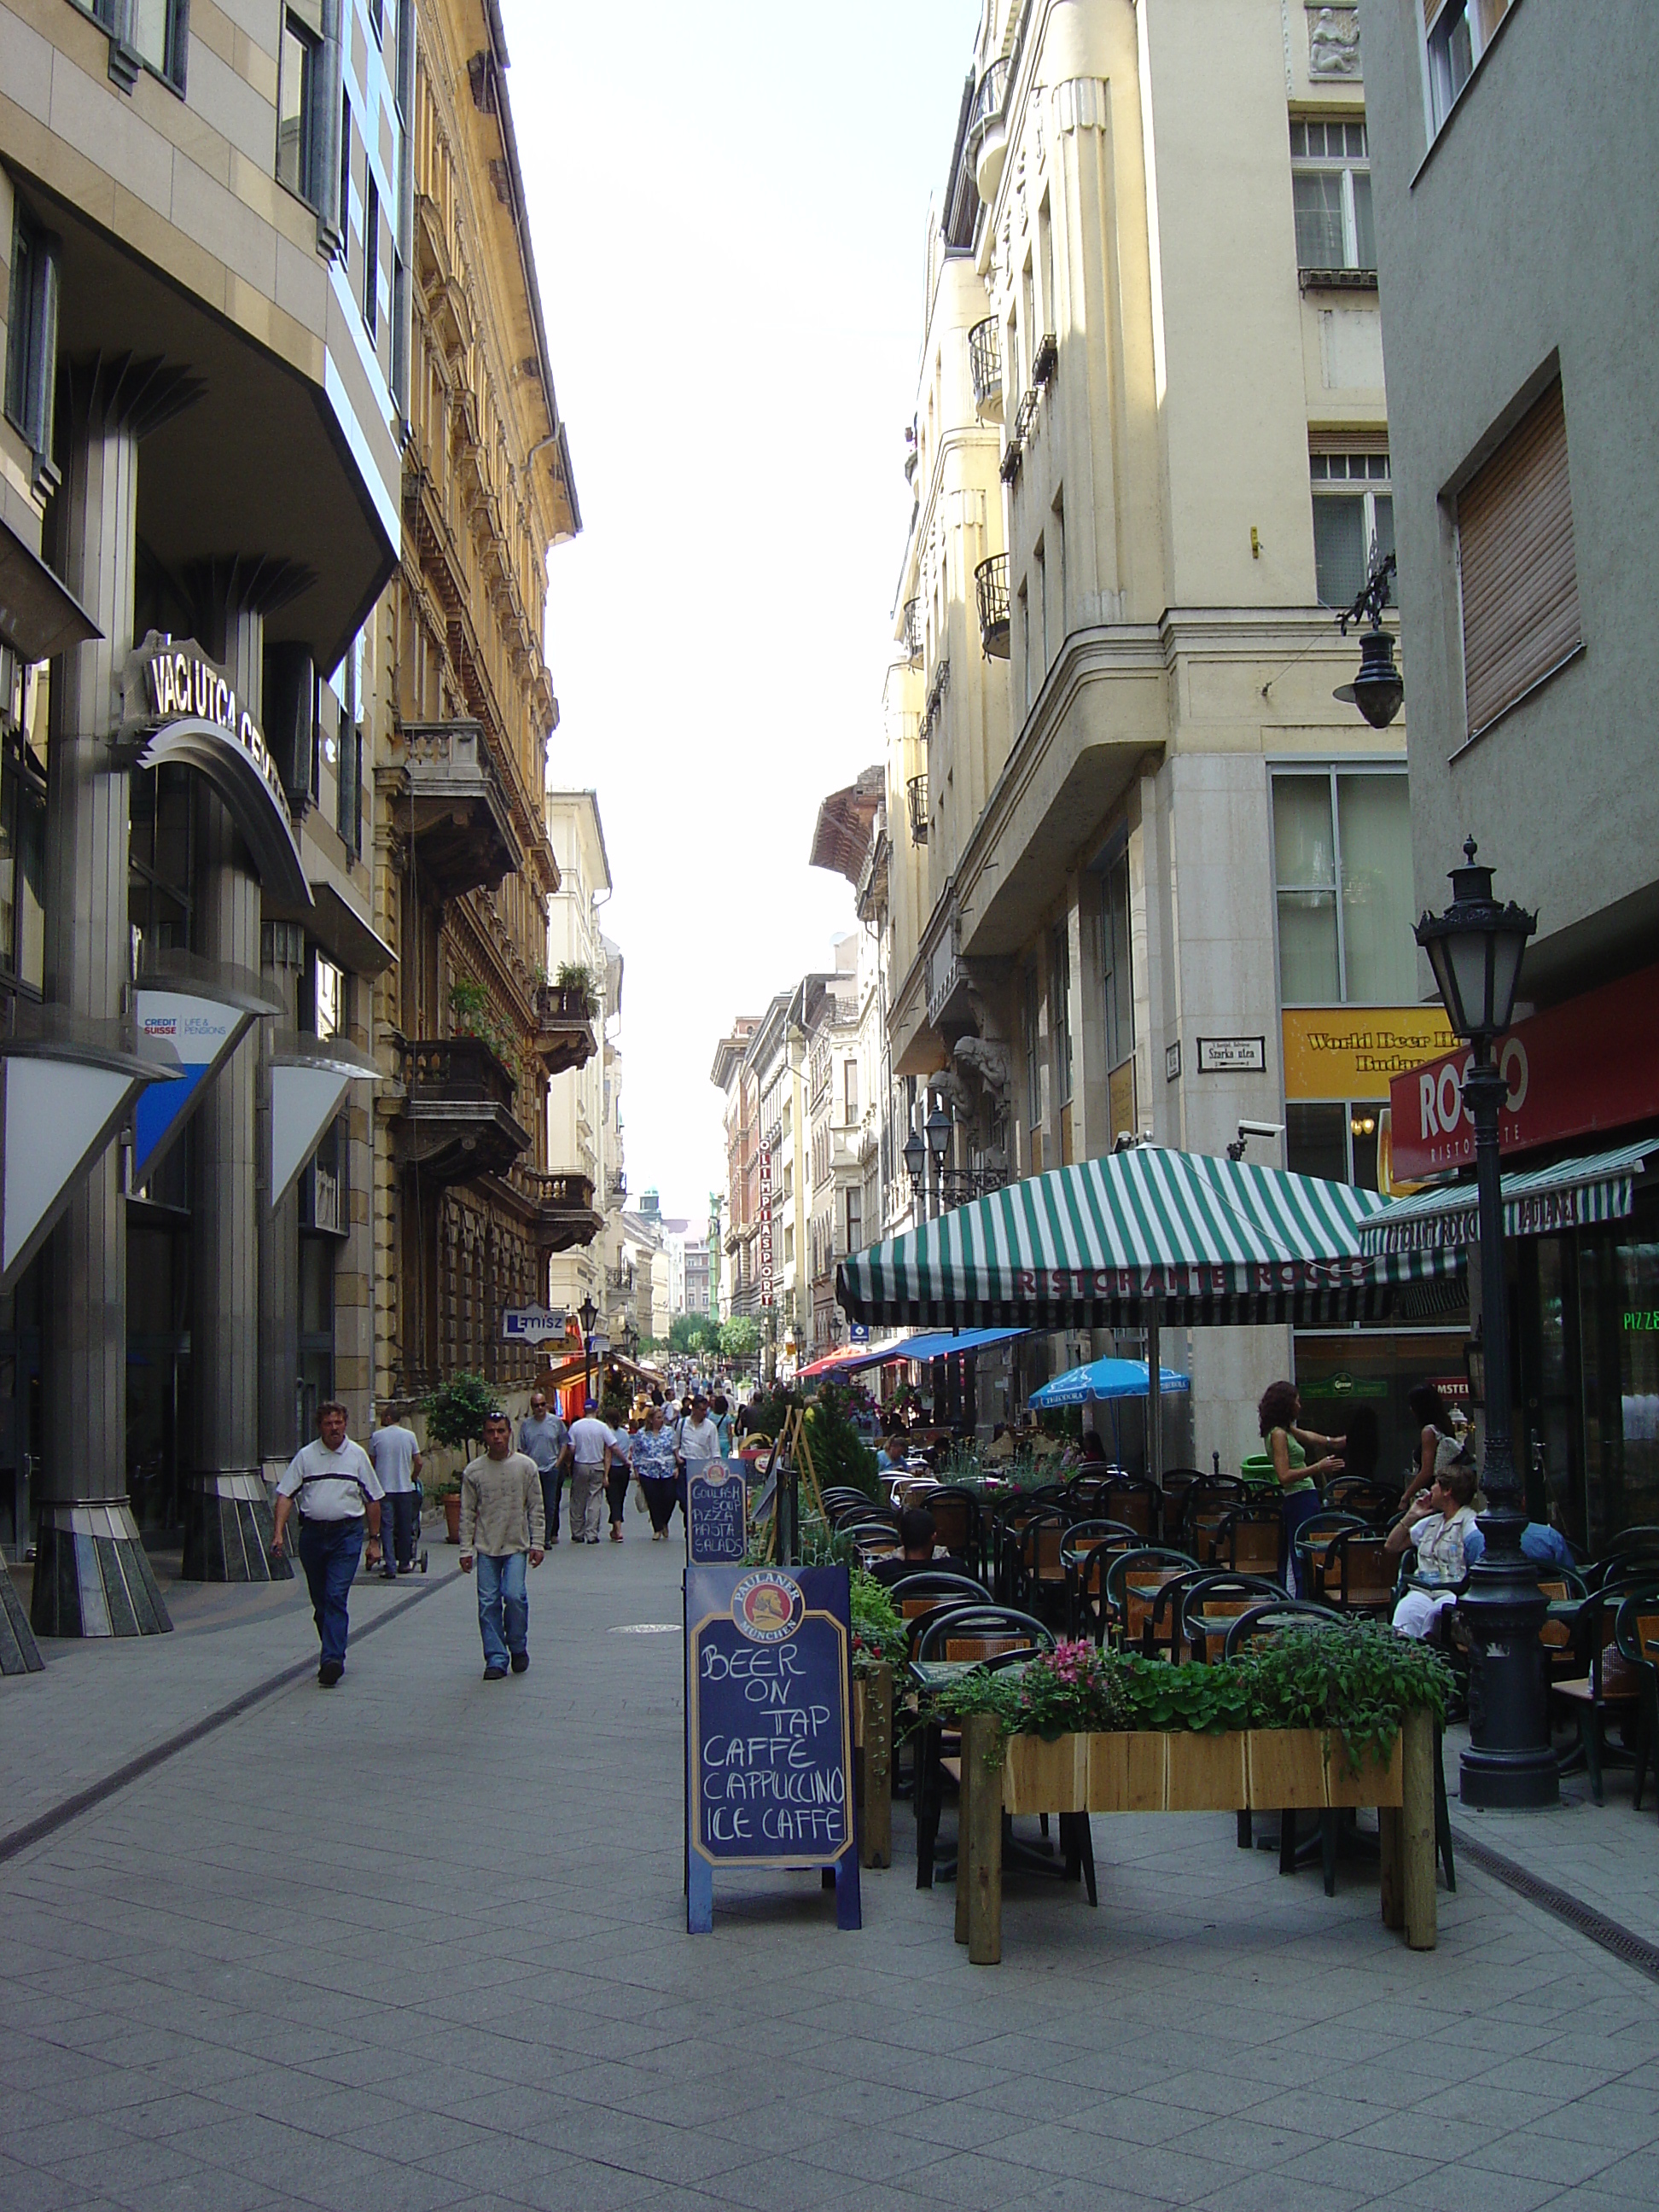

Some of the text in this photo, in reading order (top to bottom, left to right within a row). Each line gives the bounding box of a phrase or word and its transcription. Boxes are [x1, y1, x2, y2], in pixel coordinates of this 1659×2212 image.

[195, 660, 236, 730] UTCA
[1208, 1047, 1254, 1059] Szarka utca
[1307, 1033, 1372, 1051] World
[1377, 1032, 1431, 1049] Beer
[1419, 1037, 1528, 1140] ROO
[760, 1140, 772, 1306] OLIMPIASPORT
[1016, 1256, 1365, 1295] RISTORANTE ROCCO
[1046, 1392, 1083, 1404] THEODORA
[1431, 1383, 1469, 1394] MSTEL
[692, 1486, 741, 1499] GOULASH
[713, 1499, 742, 1512] SOUP
[692, 1509, 733, 1522] PIZZA
[693, 1522, 735, 1537] PASTA
[696, 1538, 743, 1557] SALADS
[734, 1572, 801, 1603] PAULANER
[701, 1644, 807, 1680] BEER
[745, 1679, 792, 1705] ON
[760, 1706, 830, 1738] TAP
[703, 1767, 845, 1804] CAPPUCCINO
[707, 1807, 753, 1841] ICE
